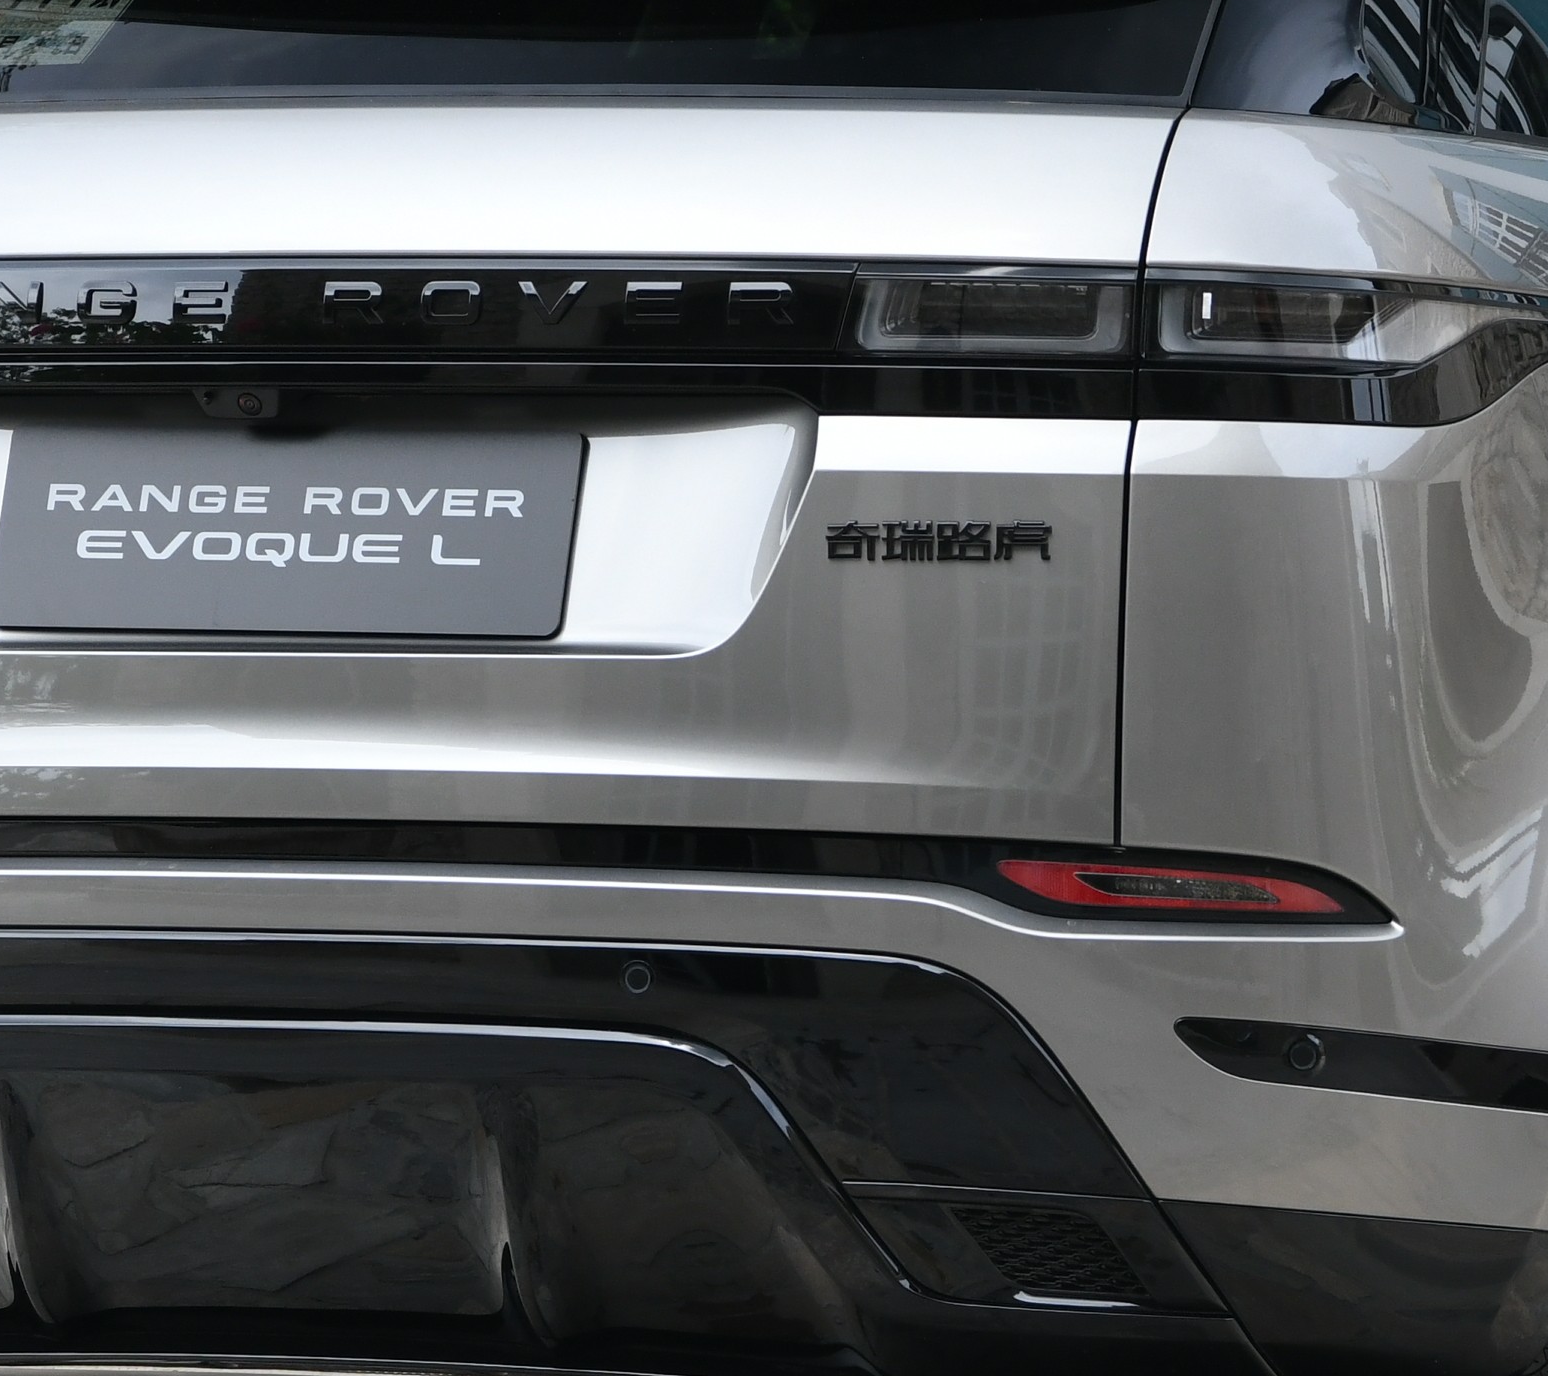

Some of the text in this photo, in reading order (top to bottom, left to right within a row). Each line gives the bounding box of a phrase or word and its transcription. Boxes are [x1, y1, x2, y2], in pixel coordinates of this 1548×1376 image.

[322, 281, 794, 325] ROVER
[46, 484, 525, 518] RANGE ROVER
[76, 531, 481, 567] EVOQUE L
[825, 520, 1052, 562] 奇瑞路虎
